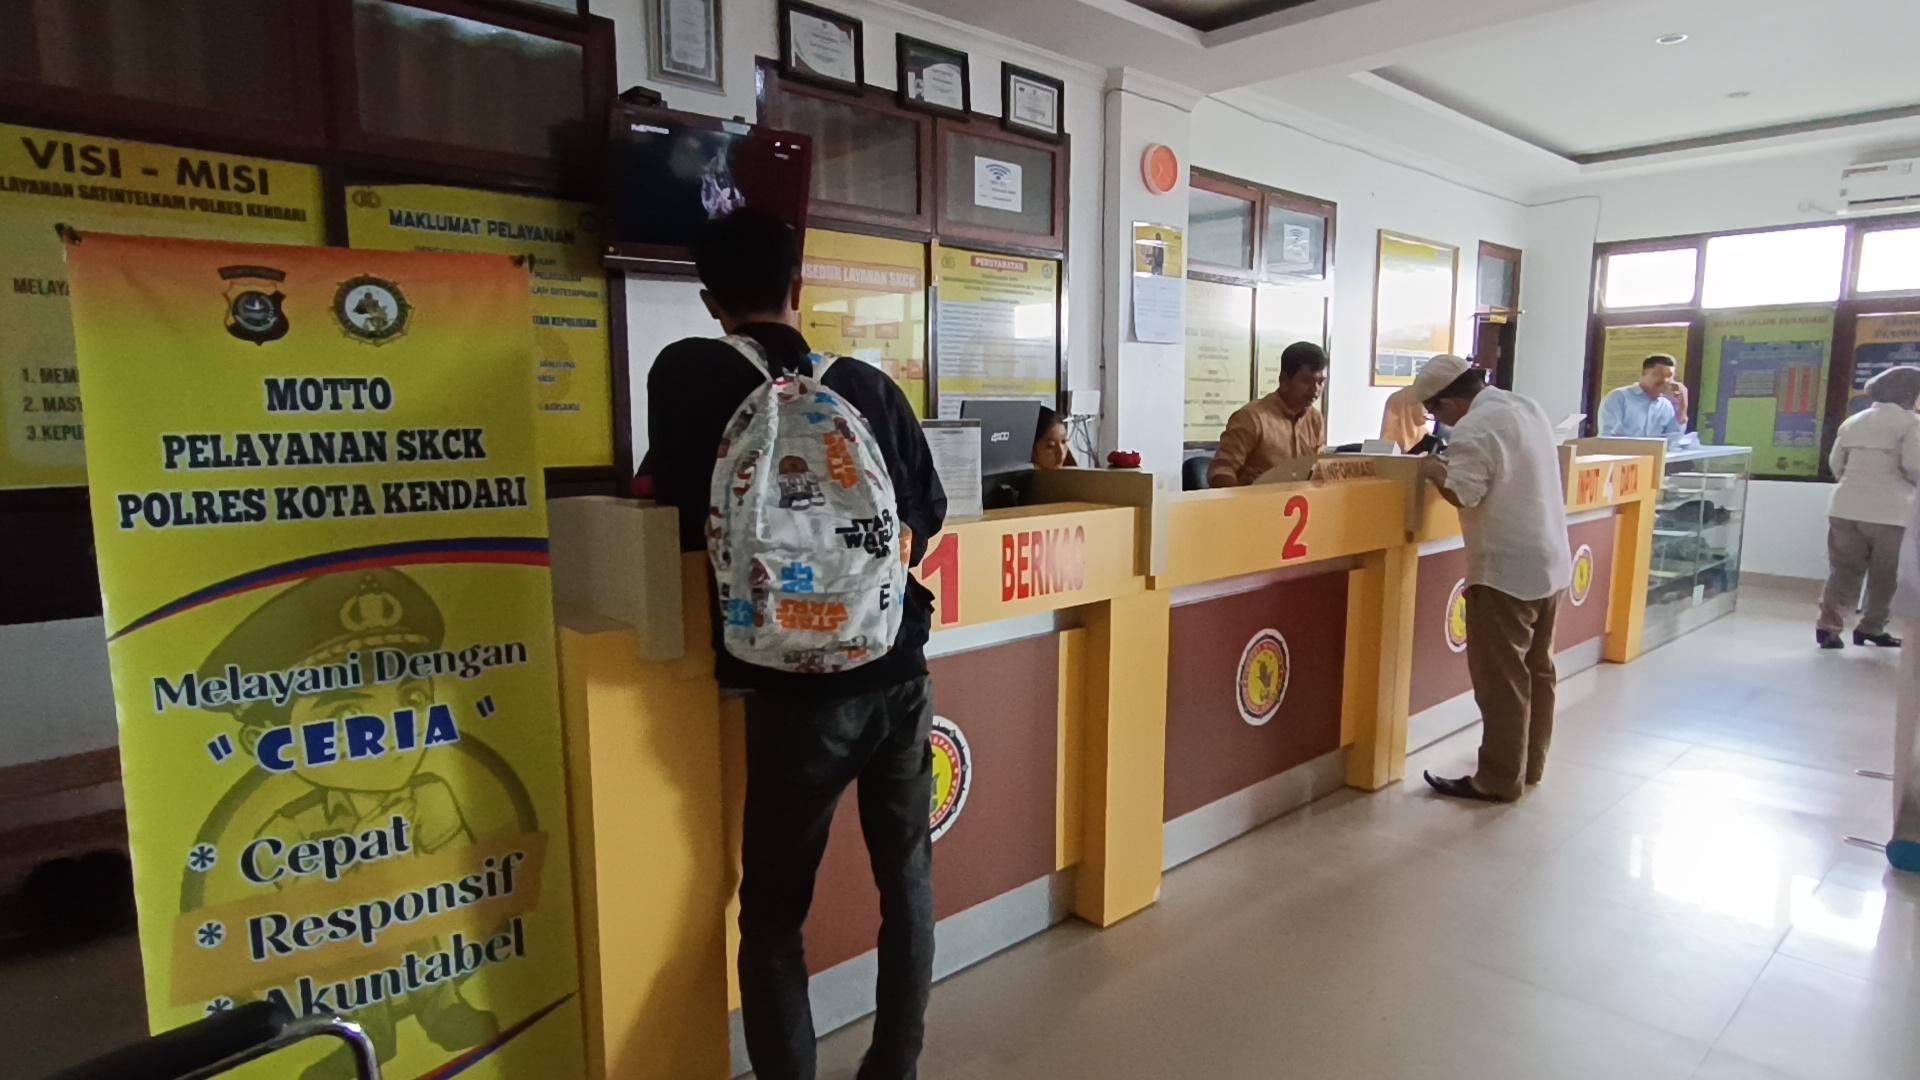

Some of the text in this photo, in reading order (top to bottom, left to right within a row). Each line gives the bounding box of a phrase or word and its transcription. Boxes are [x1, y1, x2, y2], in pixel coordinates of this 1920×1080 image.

[20, 137, 122, 178] VISI
[176, 156, 269, 195] MISI
[0, 176, 75, 198] LAYANAN
[188, 197, 244, 215] POLRES
[246, 203, 307, 222] KENDARI
[388, 209, 577, 245] MAKLUMAT PELAYANAN
[264, 376, 392, 412] MOTTO
[162, 427, 487, 470] PELAYANAN SKCK
[117, 476, 528, 530] POLRES KOTA KENDARI
[1620, 464, 1639, 497] DATA
[835, 509, 893, 534] STAR
[1282, 496, 1309, 560] 2
[922, 533, 959, 625] 1
[153, 641, 528, 713] Melayani Dengan
[256, 704, 459, 772] CERIA
[240, 815, 411, 885] Cepat
[248, 850, 524, 962] Responsif
[262, 917, 526, 1022] Akuntabel
